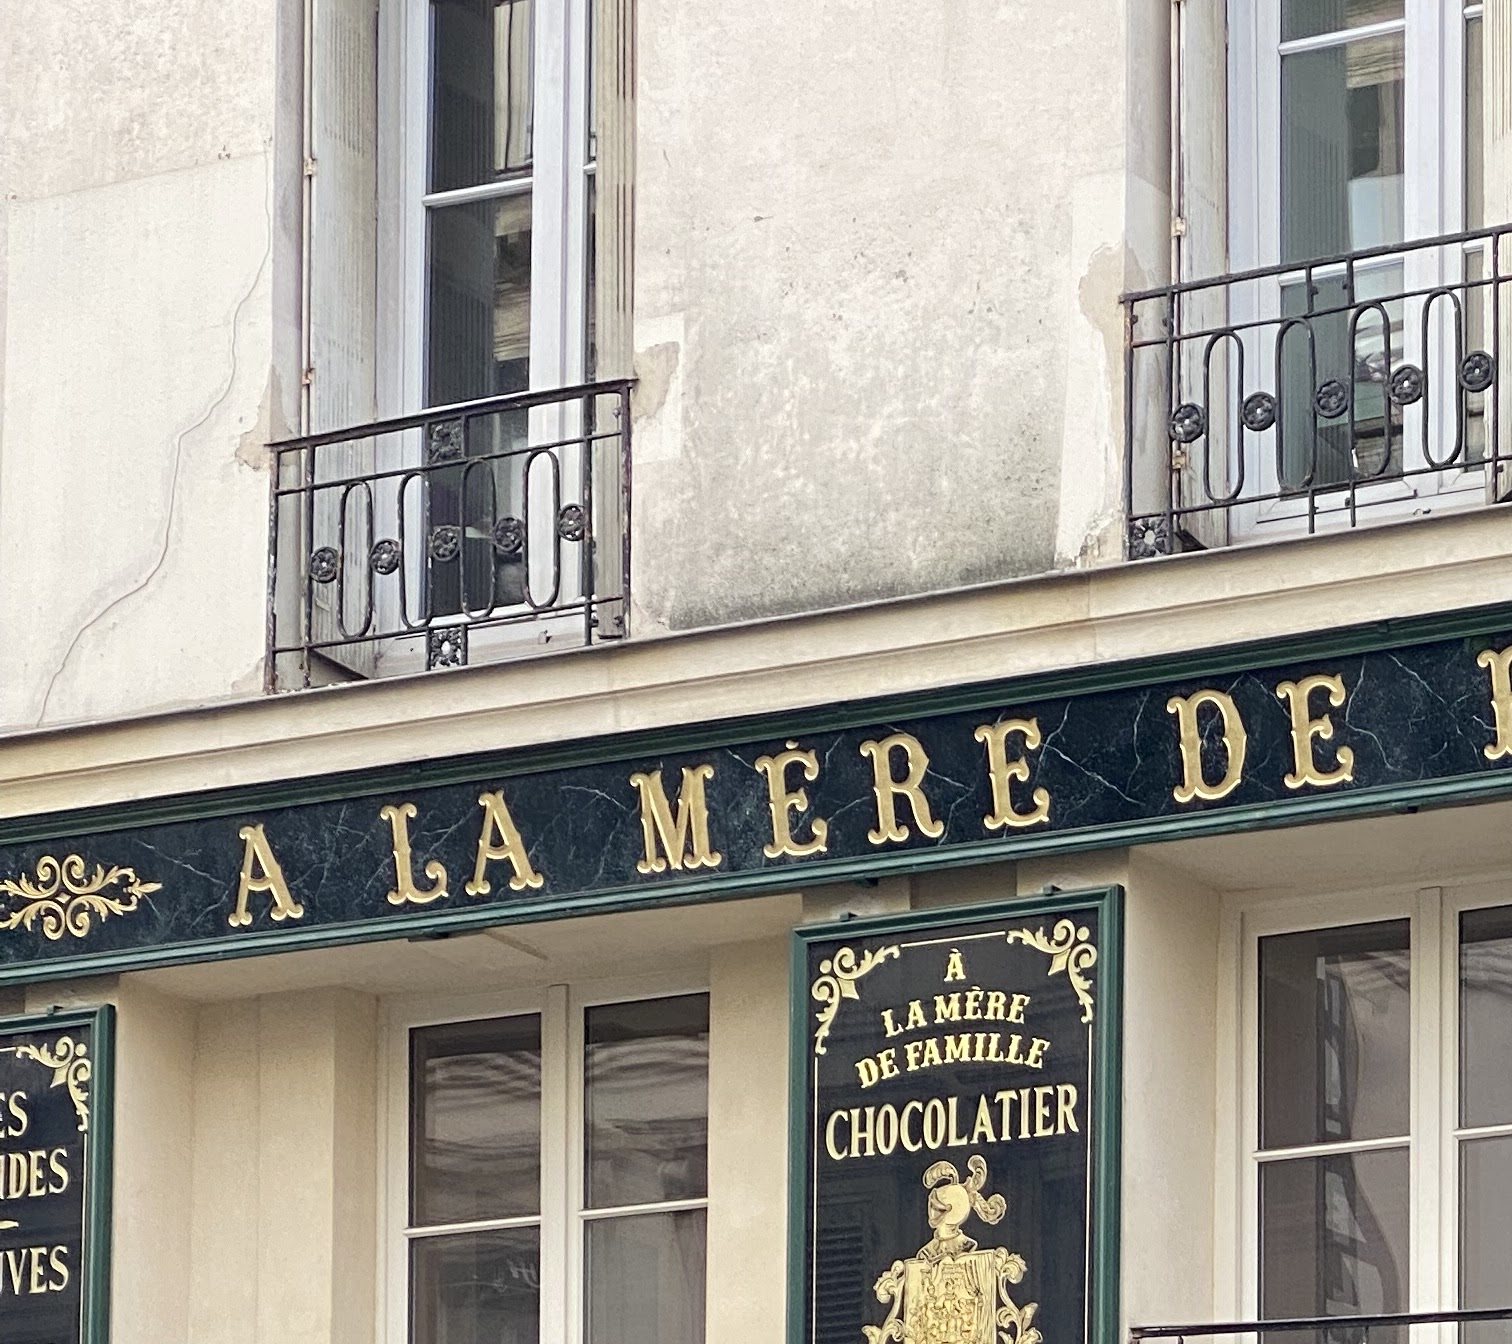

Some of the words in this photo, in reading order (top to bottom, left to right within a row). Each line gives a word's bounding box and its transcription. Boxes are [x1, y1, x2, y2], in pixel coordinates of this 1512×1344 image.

[229, 822, 304, 927] A
[382, 789, 544, 906] LA
[630, 716, 1051, 873] MÈRE
[1166, 671, 1354, 803] DE
[943, 947, 966, 982] À
[881, 1000, 928, 1038] LA
[933, 986, 1030, 1025] MÈRE
[855, 1047, 900, 1089] DE
[904, 1031, 1050, 1073] FAMILLE
[825, 1083, 1080, 1160] CHOCOLATIER
